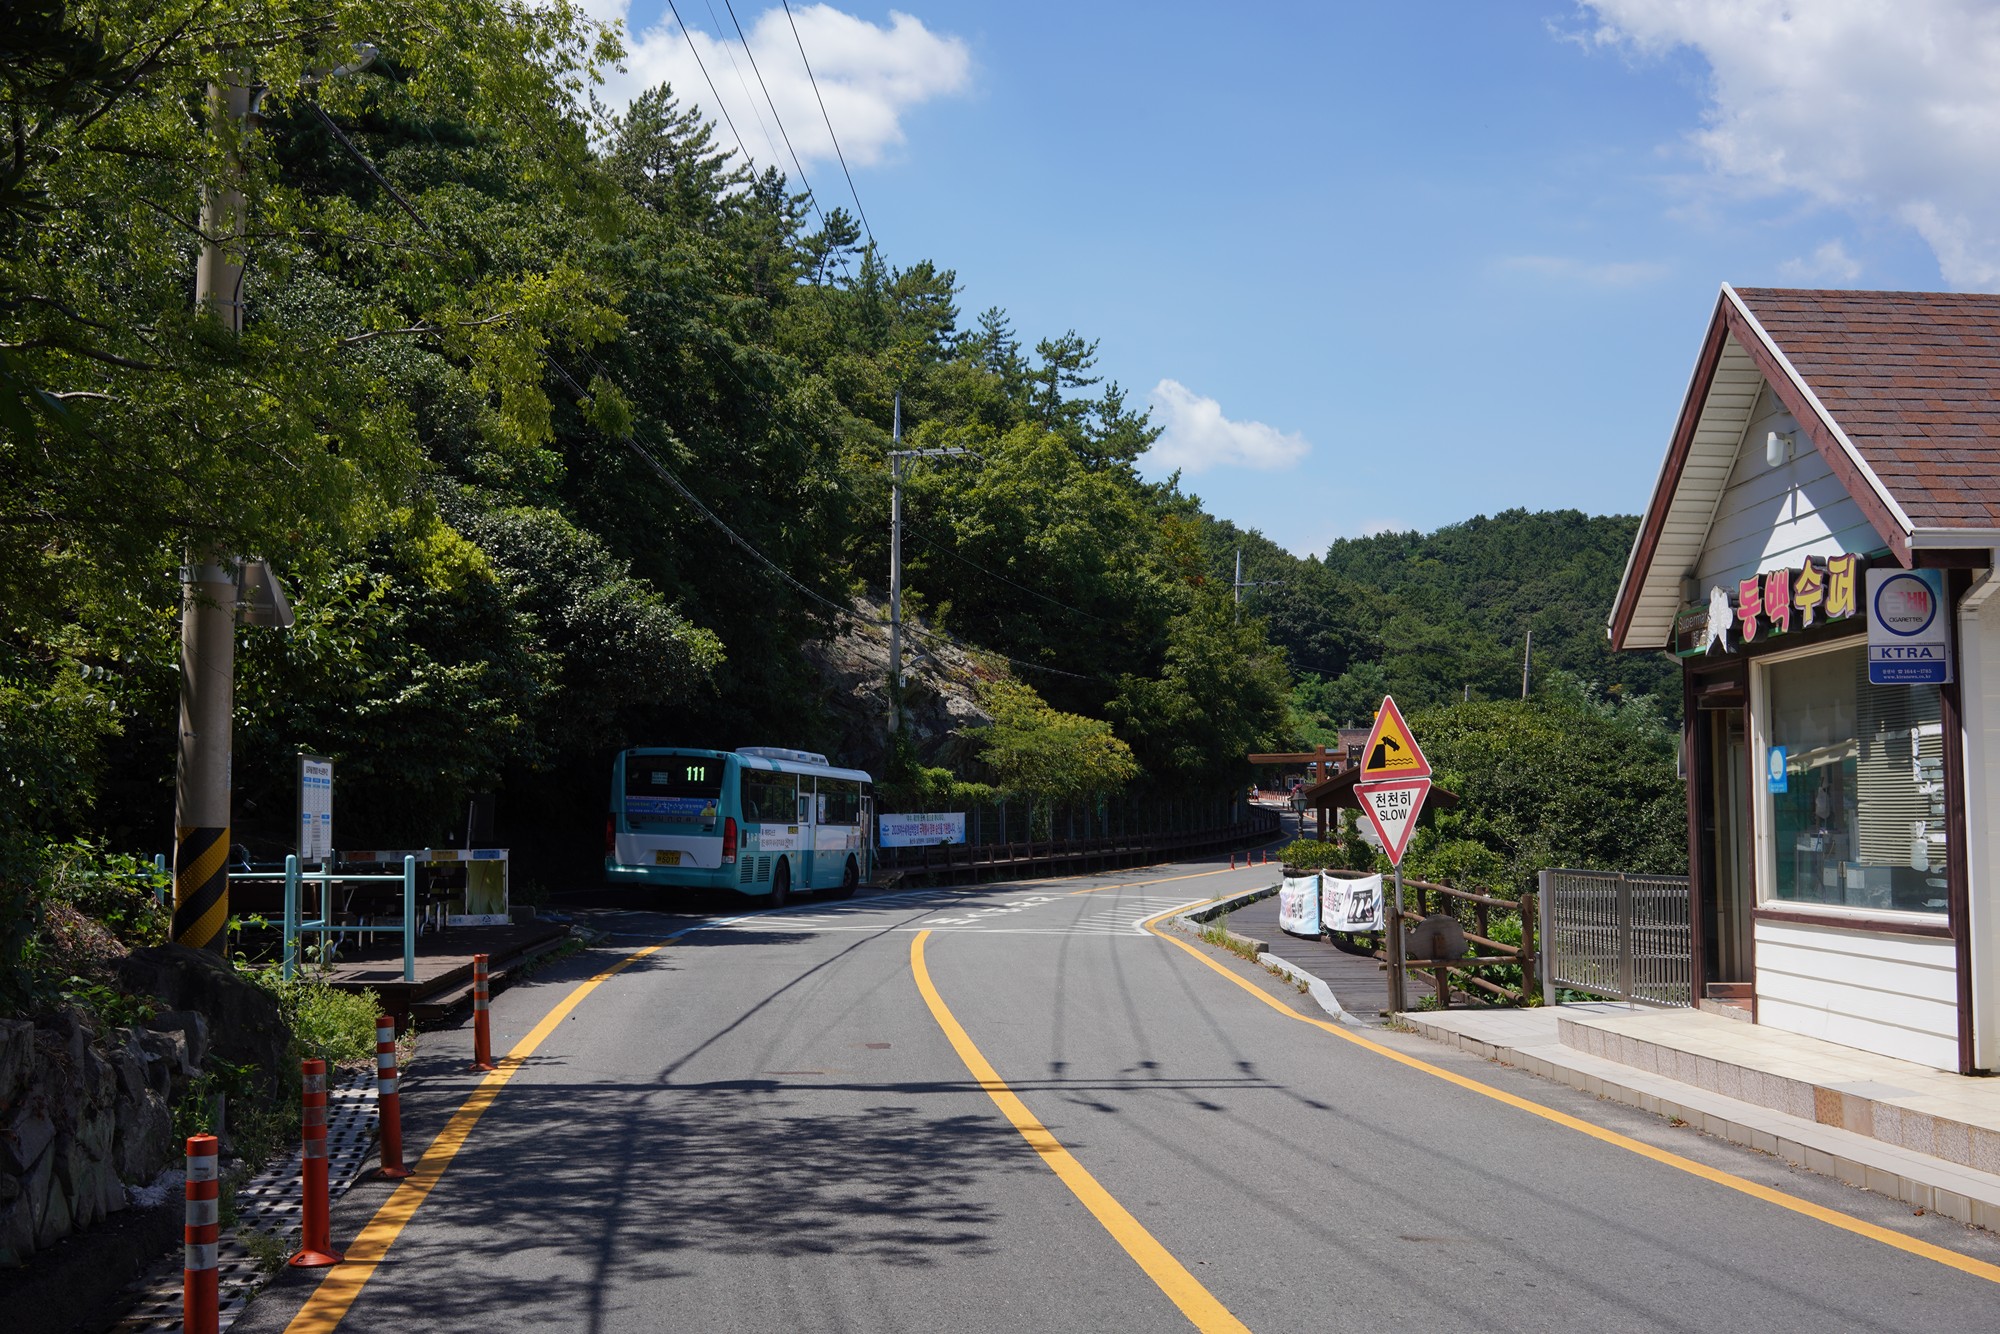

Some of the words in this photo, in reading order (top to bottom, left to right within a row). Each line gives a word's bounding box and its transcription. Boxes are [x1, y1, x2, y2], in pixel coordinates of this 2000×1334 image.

[1737, 553, 1857, 643] 동백수퍼
[1881, 647, 1933, 658] KTRA
[686, 766, 705, 781] 111
[1375, 791, 1411, 808] 천천히
[1379, 808, 1407, 821] SLOW
